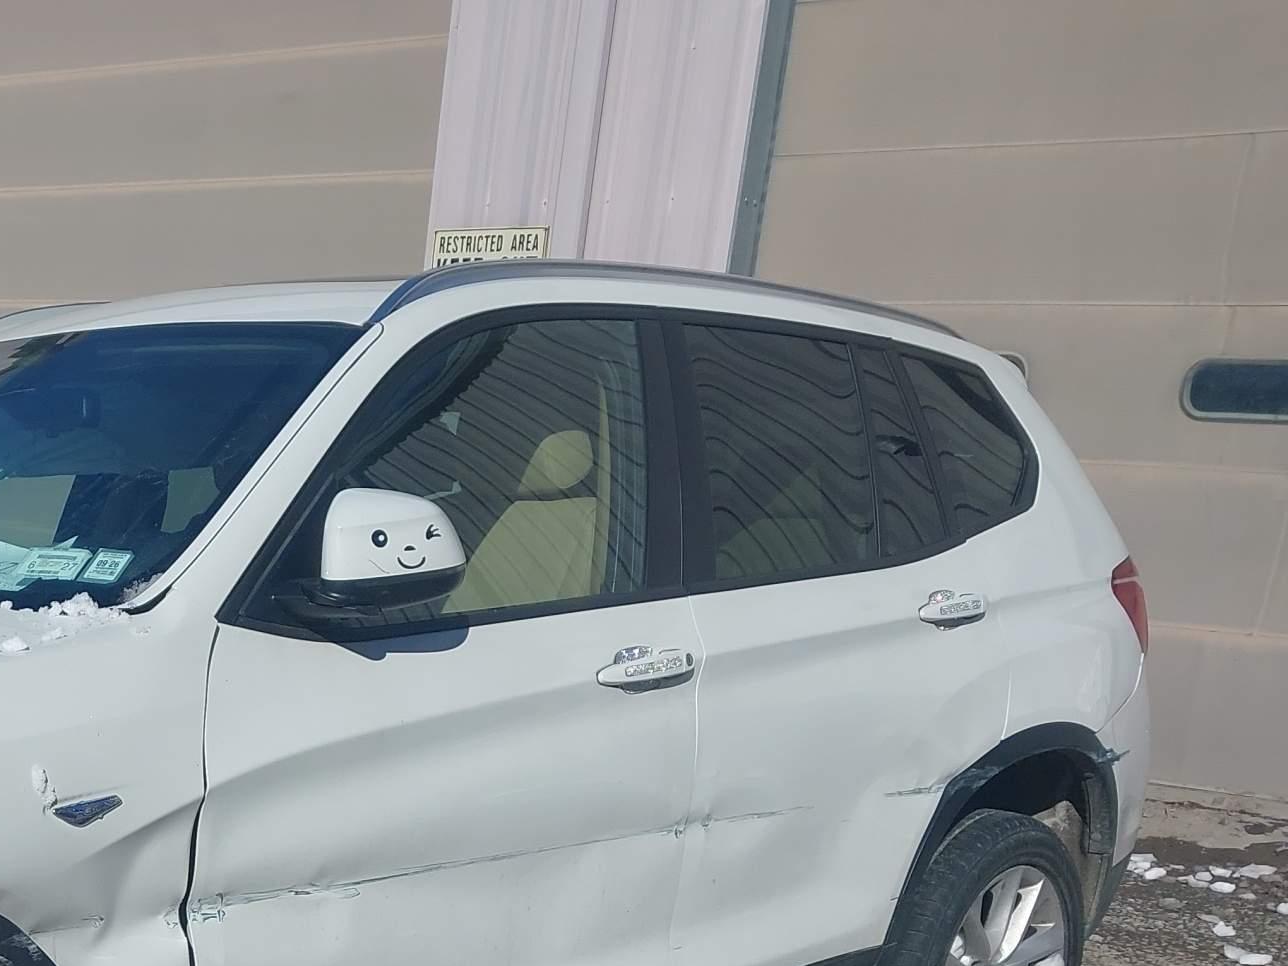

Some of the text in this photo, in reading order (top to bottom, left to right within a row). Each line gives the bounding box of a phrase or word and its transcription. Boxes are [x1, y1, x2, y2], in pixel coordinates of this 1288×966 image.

[439, 233, 539, 254] RESTRICTED AREA
[28, 561, 78, 571] 6 27
